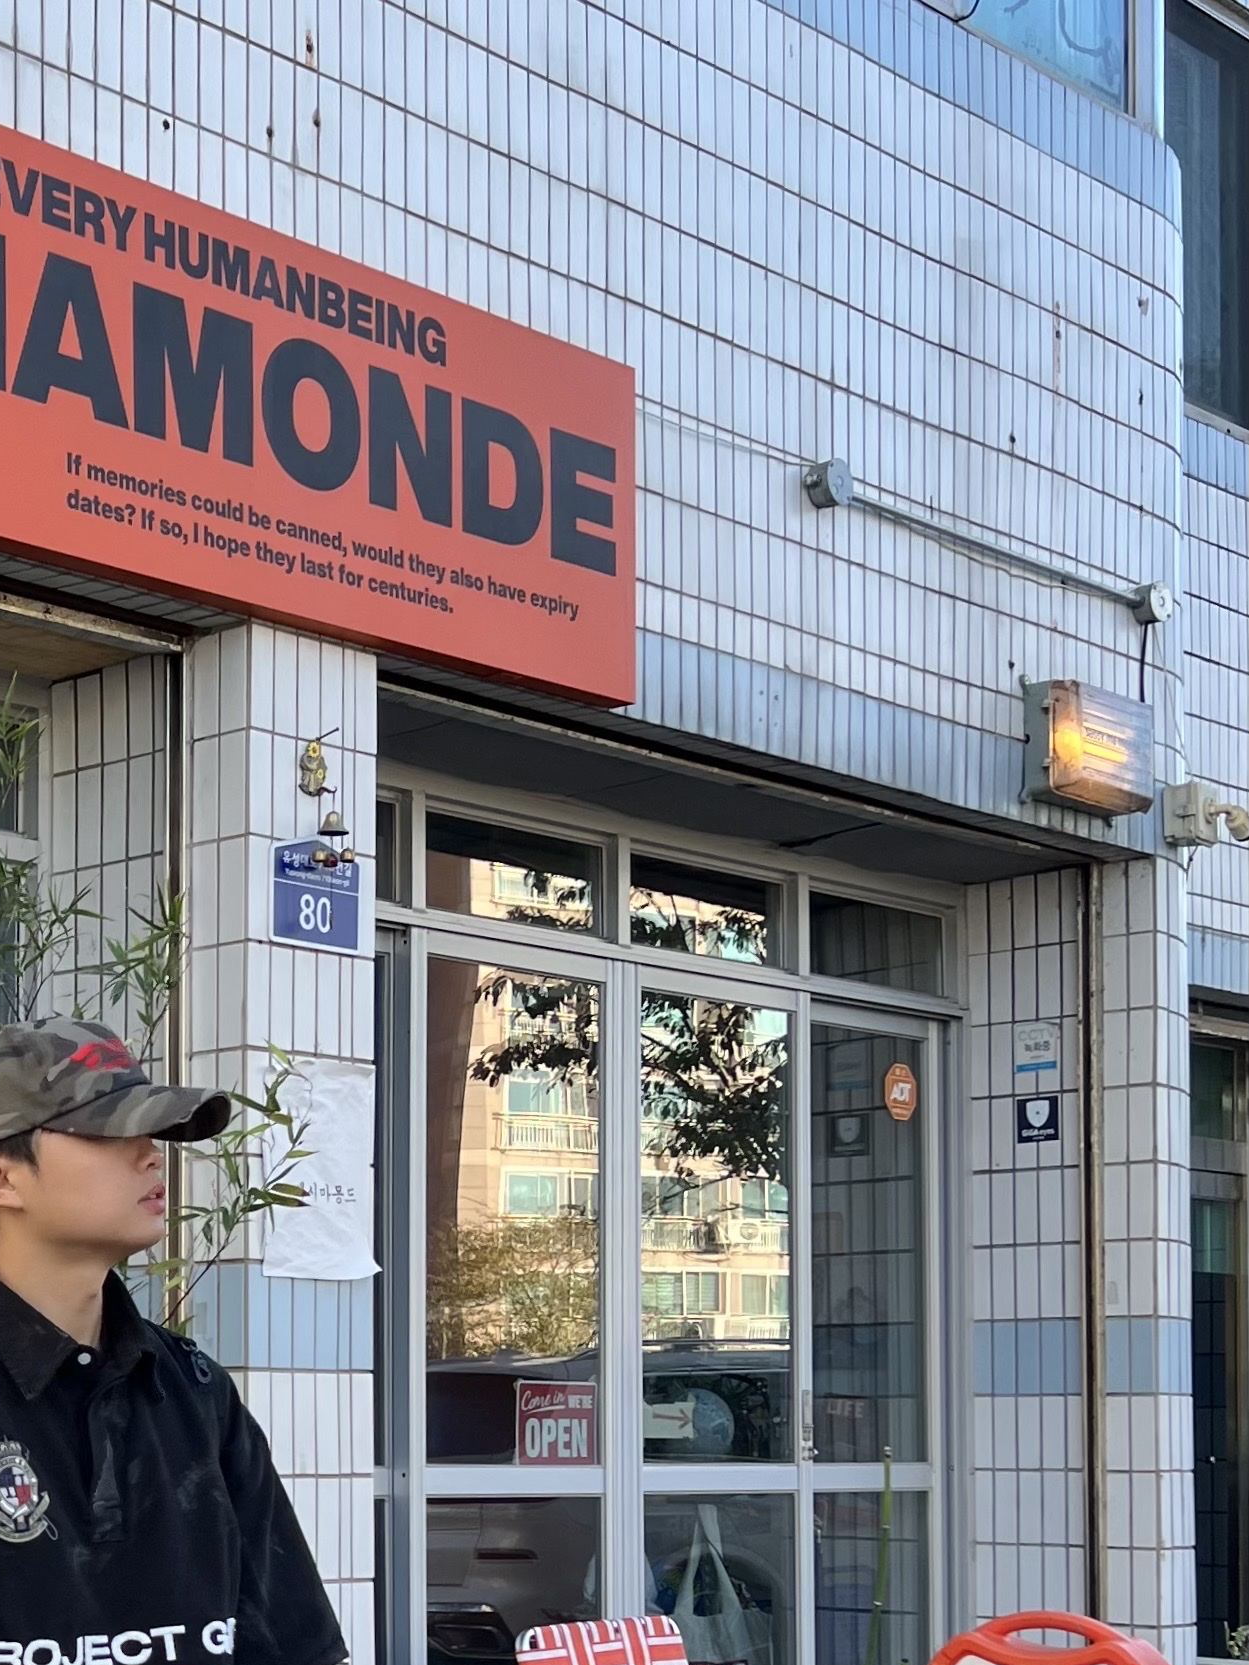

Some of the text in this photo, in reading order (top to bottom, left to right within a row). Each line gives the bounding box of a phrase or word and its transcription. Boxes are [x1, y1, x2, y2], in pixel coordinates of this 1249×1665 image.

[144, 212, 446, 367] HUMANBEING
[66, 488, 454, 613] dates? If so, I hope they last for centuries.
[67, 452, 579, 622] If memories could be canned, would they also have expiry
[299, 893, 330, 933] 80
[1017, 1027, 1056, 1042] CCTV
[889, 1082, 912, 1102] ADT
[300, 1181, 357, 1205] 시마몽드
[521, 1389, 552, 1411] Come
[553, 1390, 565, 1405] in
[525, 1417, 588, 1459] OPEN
